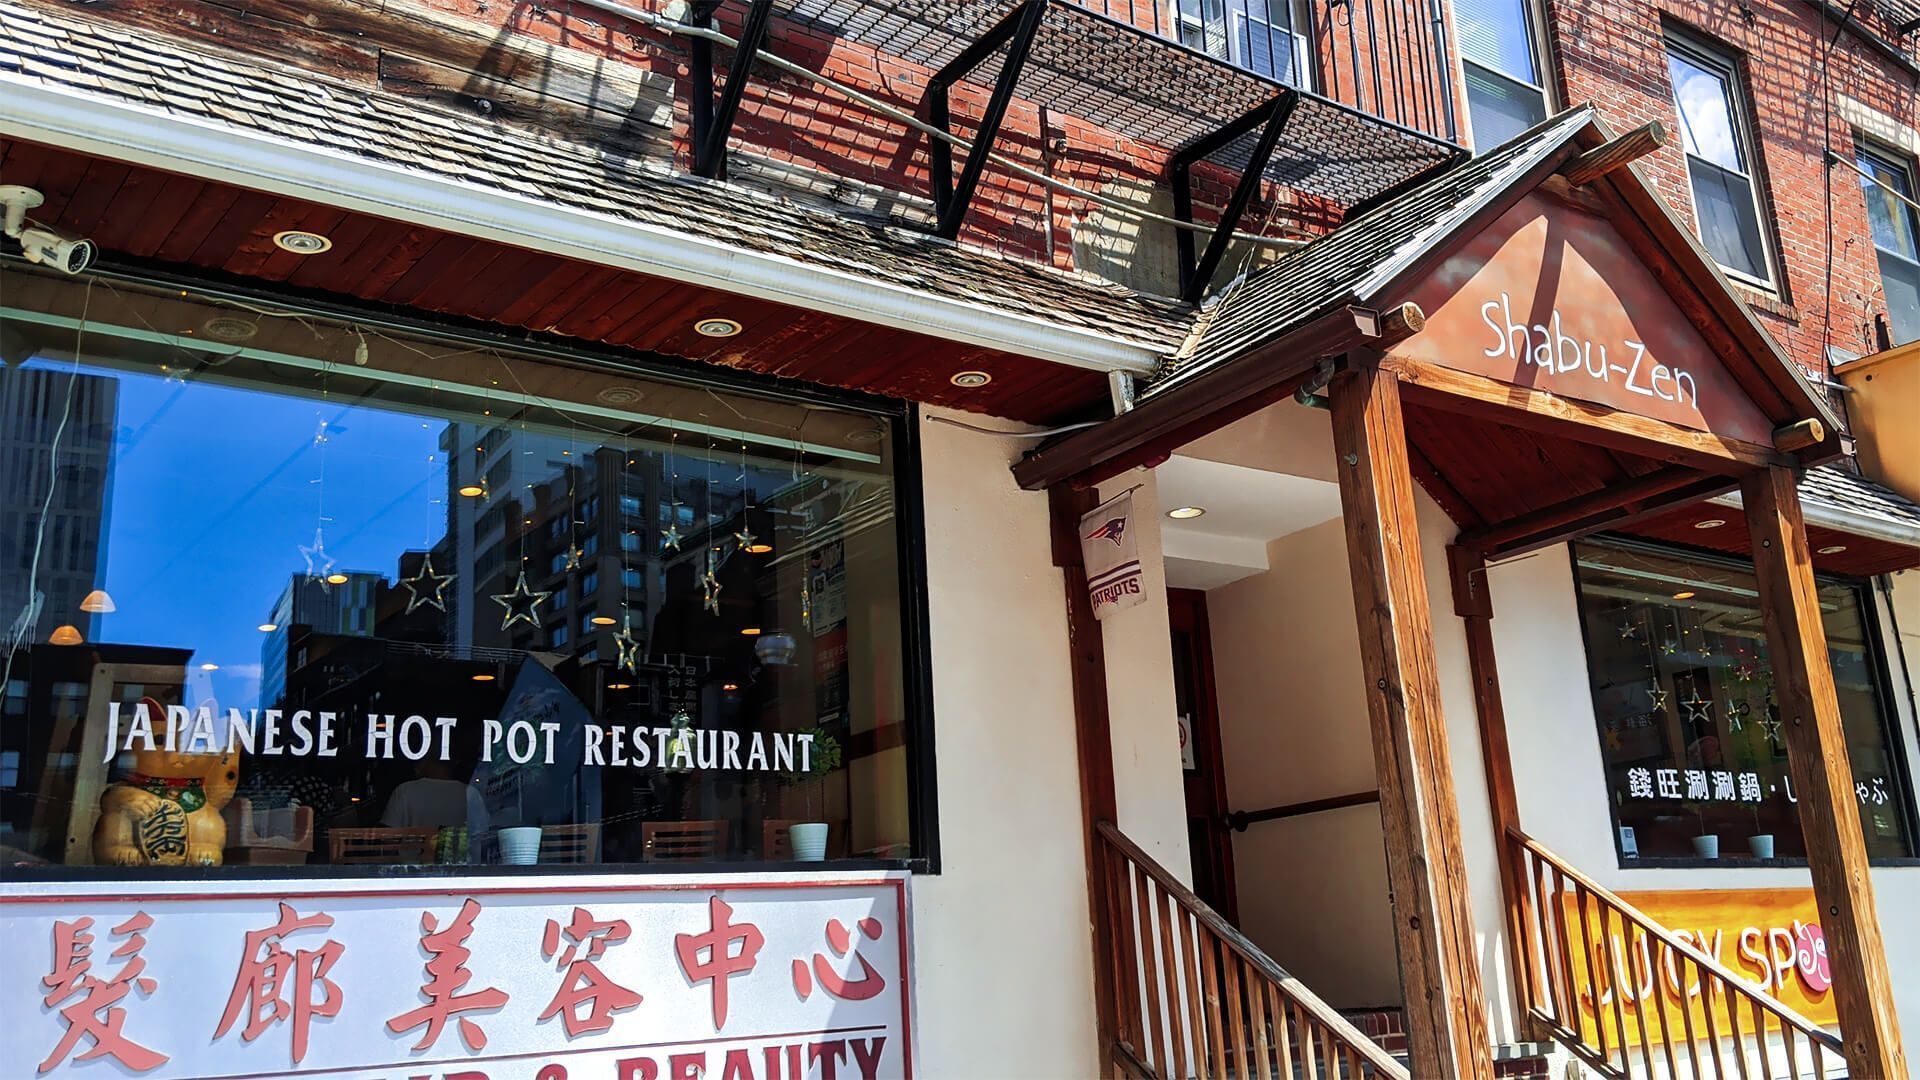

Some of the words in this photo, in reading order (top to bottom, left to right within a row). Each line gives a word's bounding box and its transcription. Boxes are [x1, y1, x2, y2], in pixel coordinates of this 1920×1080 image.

[1481, 291, 1699, 410] Shabu-Zen
[1091, 577, 1141, 612] PATRIOTS
[103, 701, 338, 764] JAPANESE
[365, 713, 457, 761] HOT
[482, 719, 560, 765] POT
[584, 724, 814, 772] RESTAURANT
